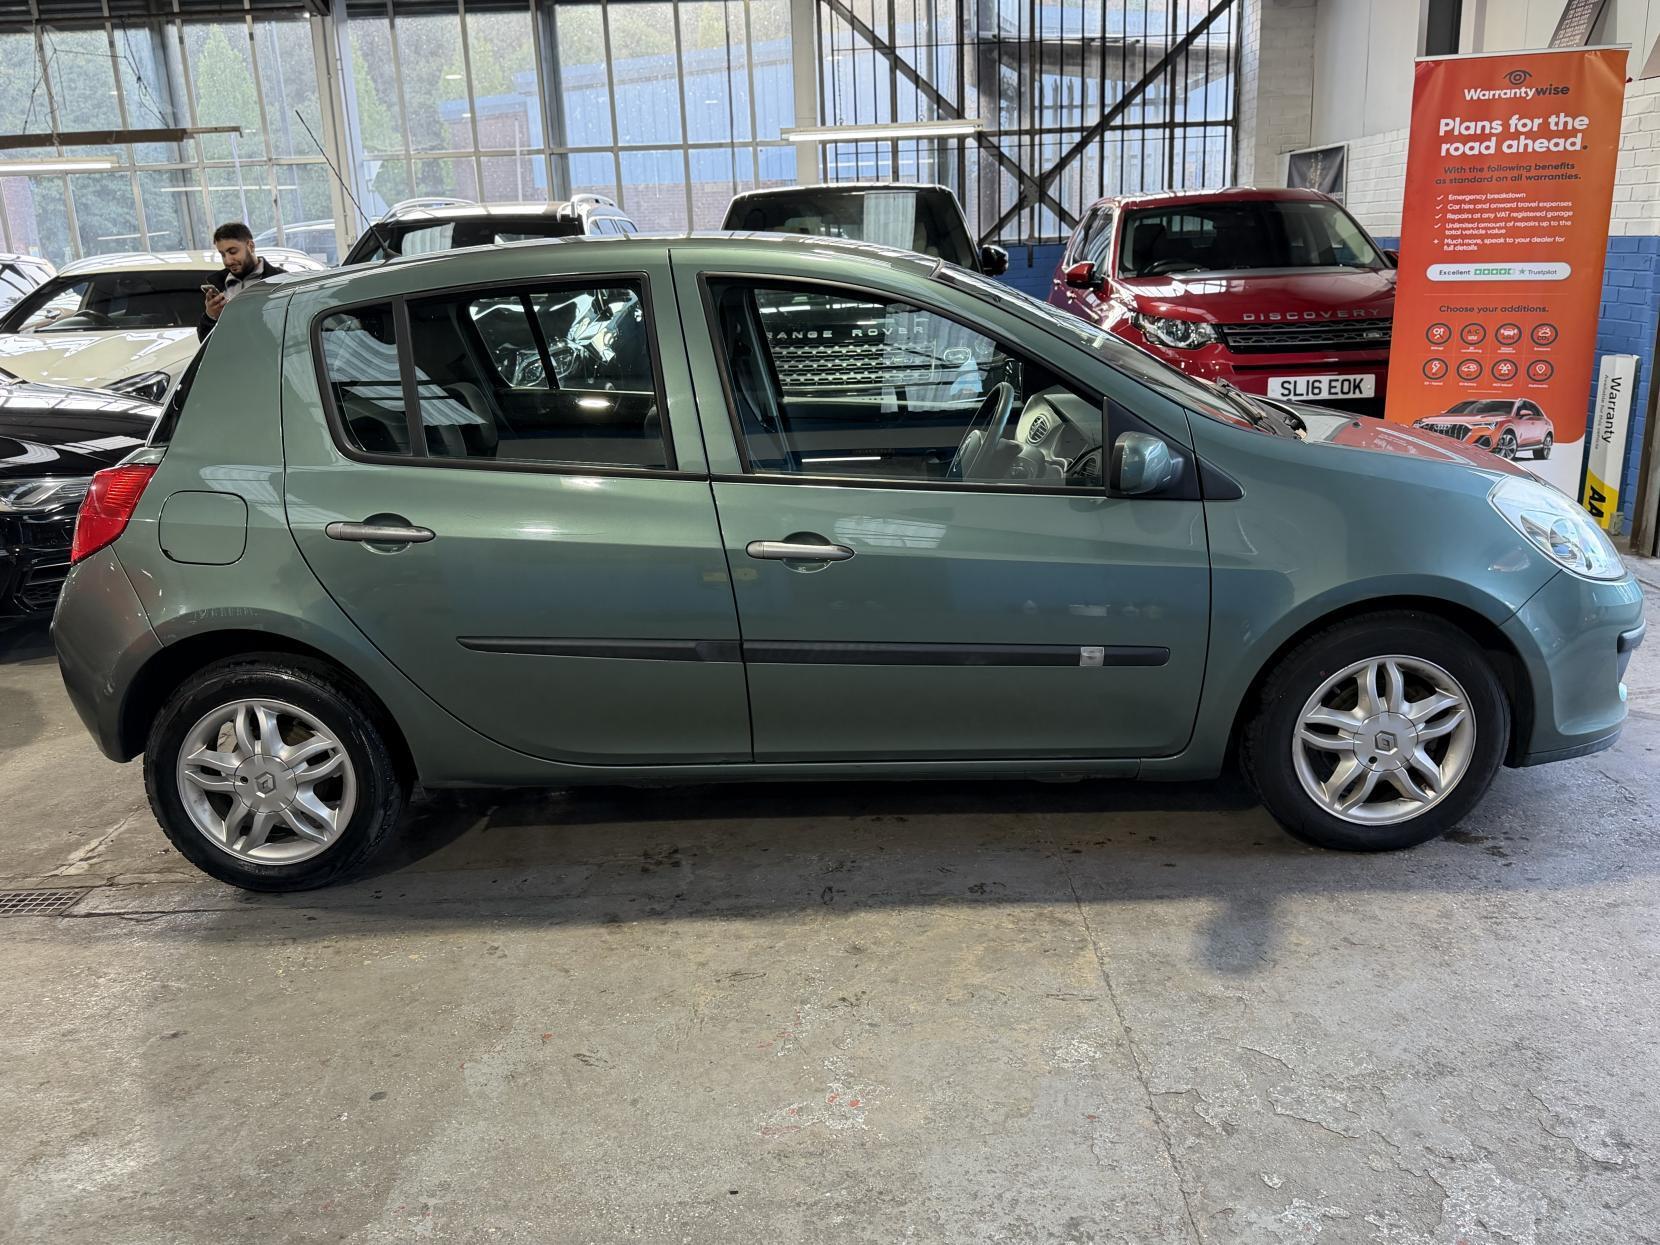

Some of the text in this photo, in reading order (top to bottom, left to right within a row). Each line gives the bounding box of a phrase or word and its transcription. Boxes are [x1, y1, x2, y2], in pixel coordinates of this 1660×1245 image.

[1464, 84, 1570, 100] Warrantywise
[1439, 113, 1589, 136] Plans for the
[1441, 133, 1588, 156] road ahead.
[1444, 162, 1575, 174] With the following benefits
[1435, 177, 1447, 185] as
[1450, 175, 1493, 184] standard
[1510, 174, 1523, 182] all
[1525, 172, 1581, 181] warranties.
[1448, 194, 1486, 202] Emergency
[1510, 210, 1546, 218] registered
[1515, 220, 1539, 228] repairs
[1243, 309, 1380, 321] DISCOVERY
[1439, 304, 1549, 314] Choose your additions.
[852, 326, 924, 337] ROVER
[1280, 378, 1364, 397] SL16 EOK
[1601, 376, 1622, 444] Warranty
[1588, 485, 1606, 519] AA
